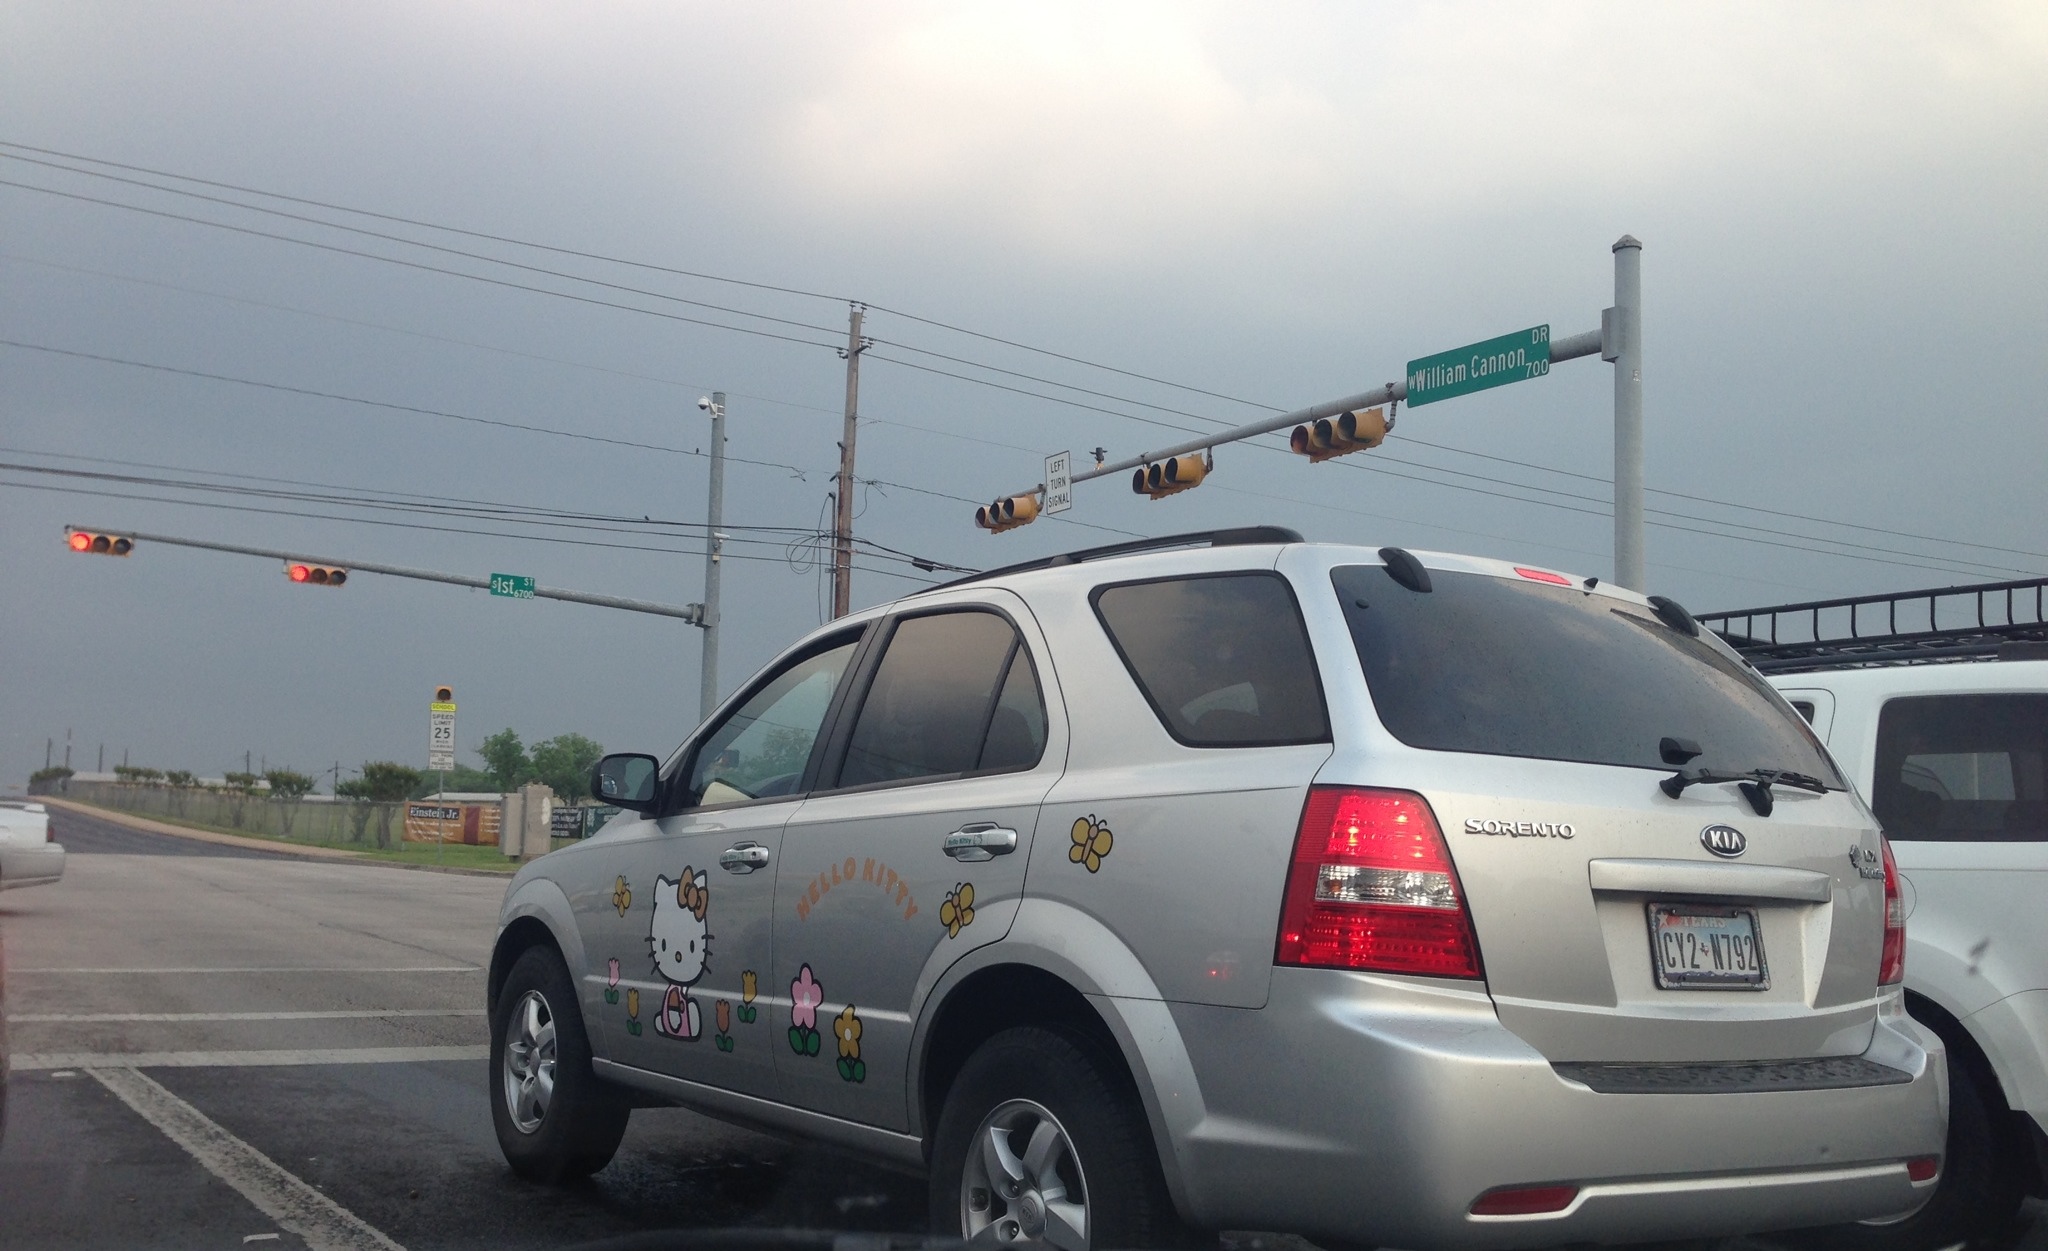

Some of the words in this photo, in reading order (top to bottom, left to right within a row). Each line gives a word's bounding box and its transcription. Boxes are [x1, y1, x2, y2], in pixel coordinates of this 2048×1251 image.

[1532, 327, 1548, 345] DR
[1415, 364, 1466, 392] William
[1471, 347, 1525, 378] Cannon
[1525, 358, 1549, 378] 700
[1050, 459, 1065, 473] LEFT
[1050, 476, 1066, 490] TURN
[1048, 492, 1069, 508] SIGNAL
[497, 577, 515, 594] 1st
[524, 578, 533, 586] ST
[514, 589, 534, 599] 6700
[434, 727, 451, 739] 25
[410, 807, 446, 818] Einstein
[446, 809, 459, 819] Jr.
[1464, 817, 1576, 839] SORENTO
[1709, 830, 1743, 851] KIA
[796, 856, 857, 922] HELLO
[863, 857, 919, 921] KITTY
[1682, 916, 1727, 928] TEXAS
